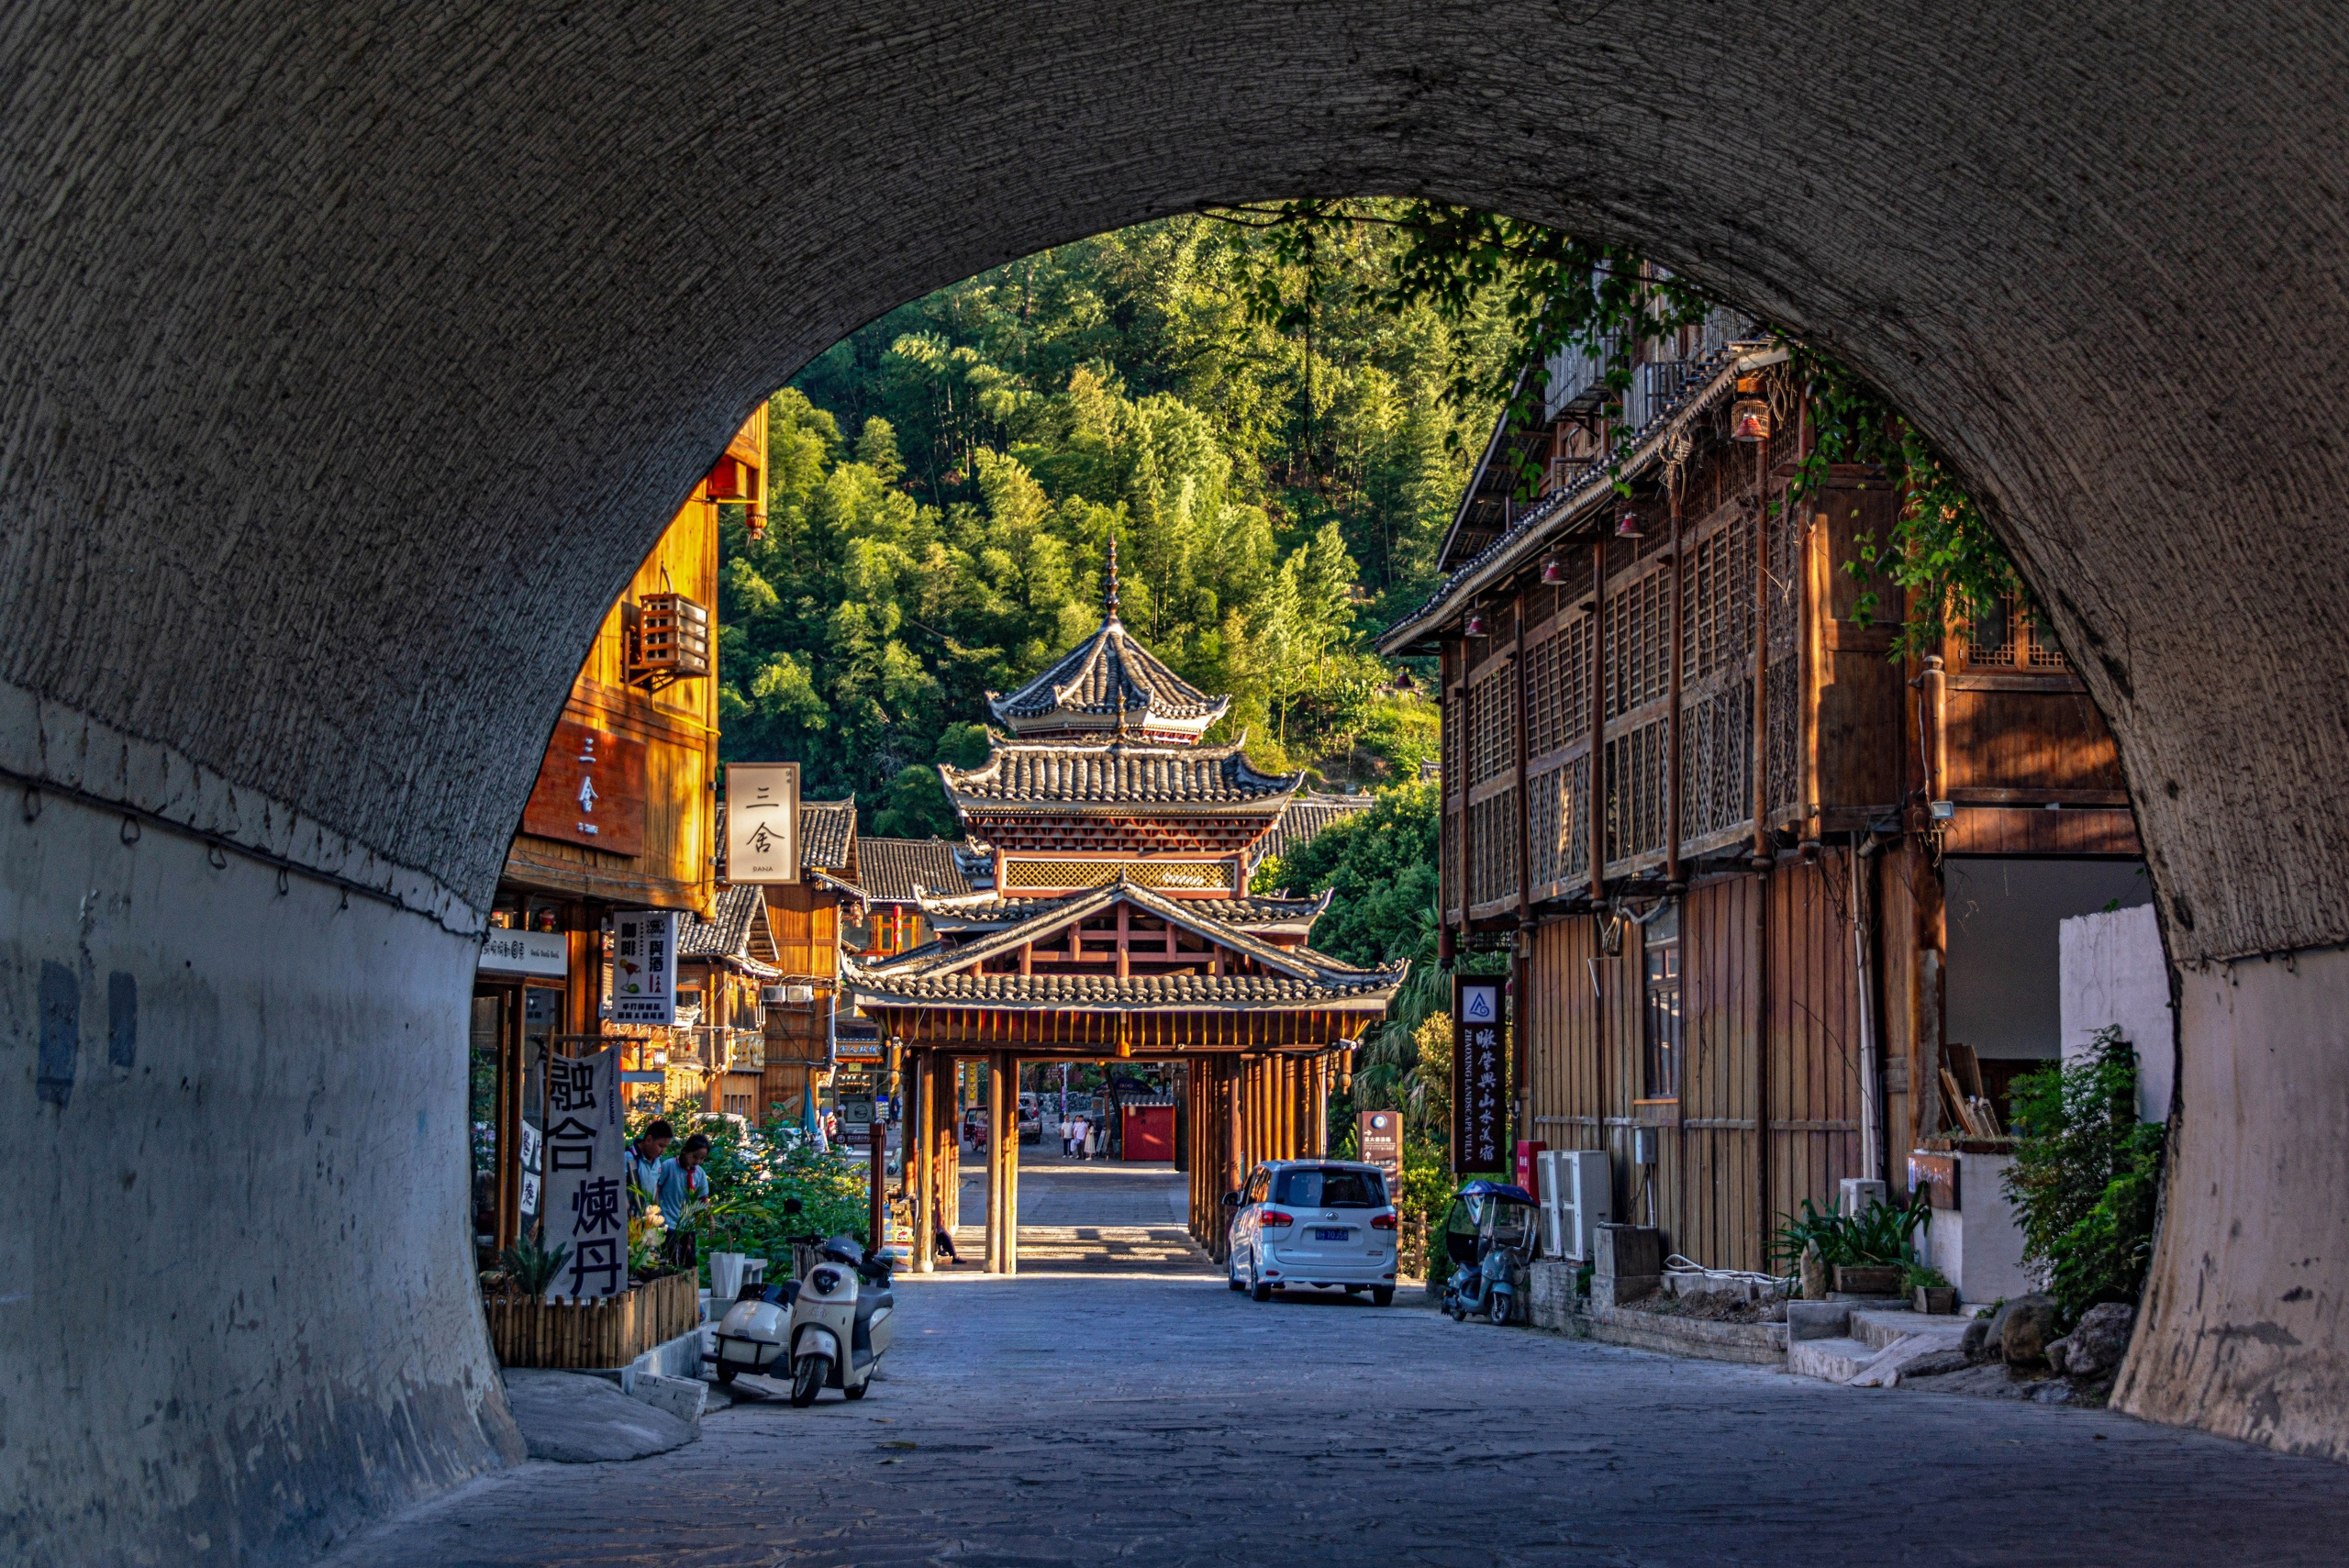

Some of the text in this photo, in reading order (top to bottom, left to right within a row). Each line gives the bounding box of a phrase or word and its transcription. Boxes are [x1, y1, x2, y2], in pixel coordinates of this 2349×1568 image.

[578, 738, 598, 813] 三舍
[745, 786, 785, 853] 三舍
[621, 922, 637, 957] 咖啡
[649, 940, 663, 973] 與酒
[543, 1059, 597, 1173] 融合
[1464, 1029, 1473, 1162] ZHAOXING LANDSCAPE VILLA
